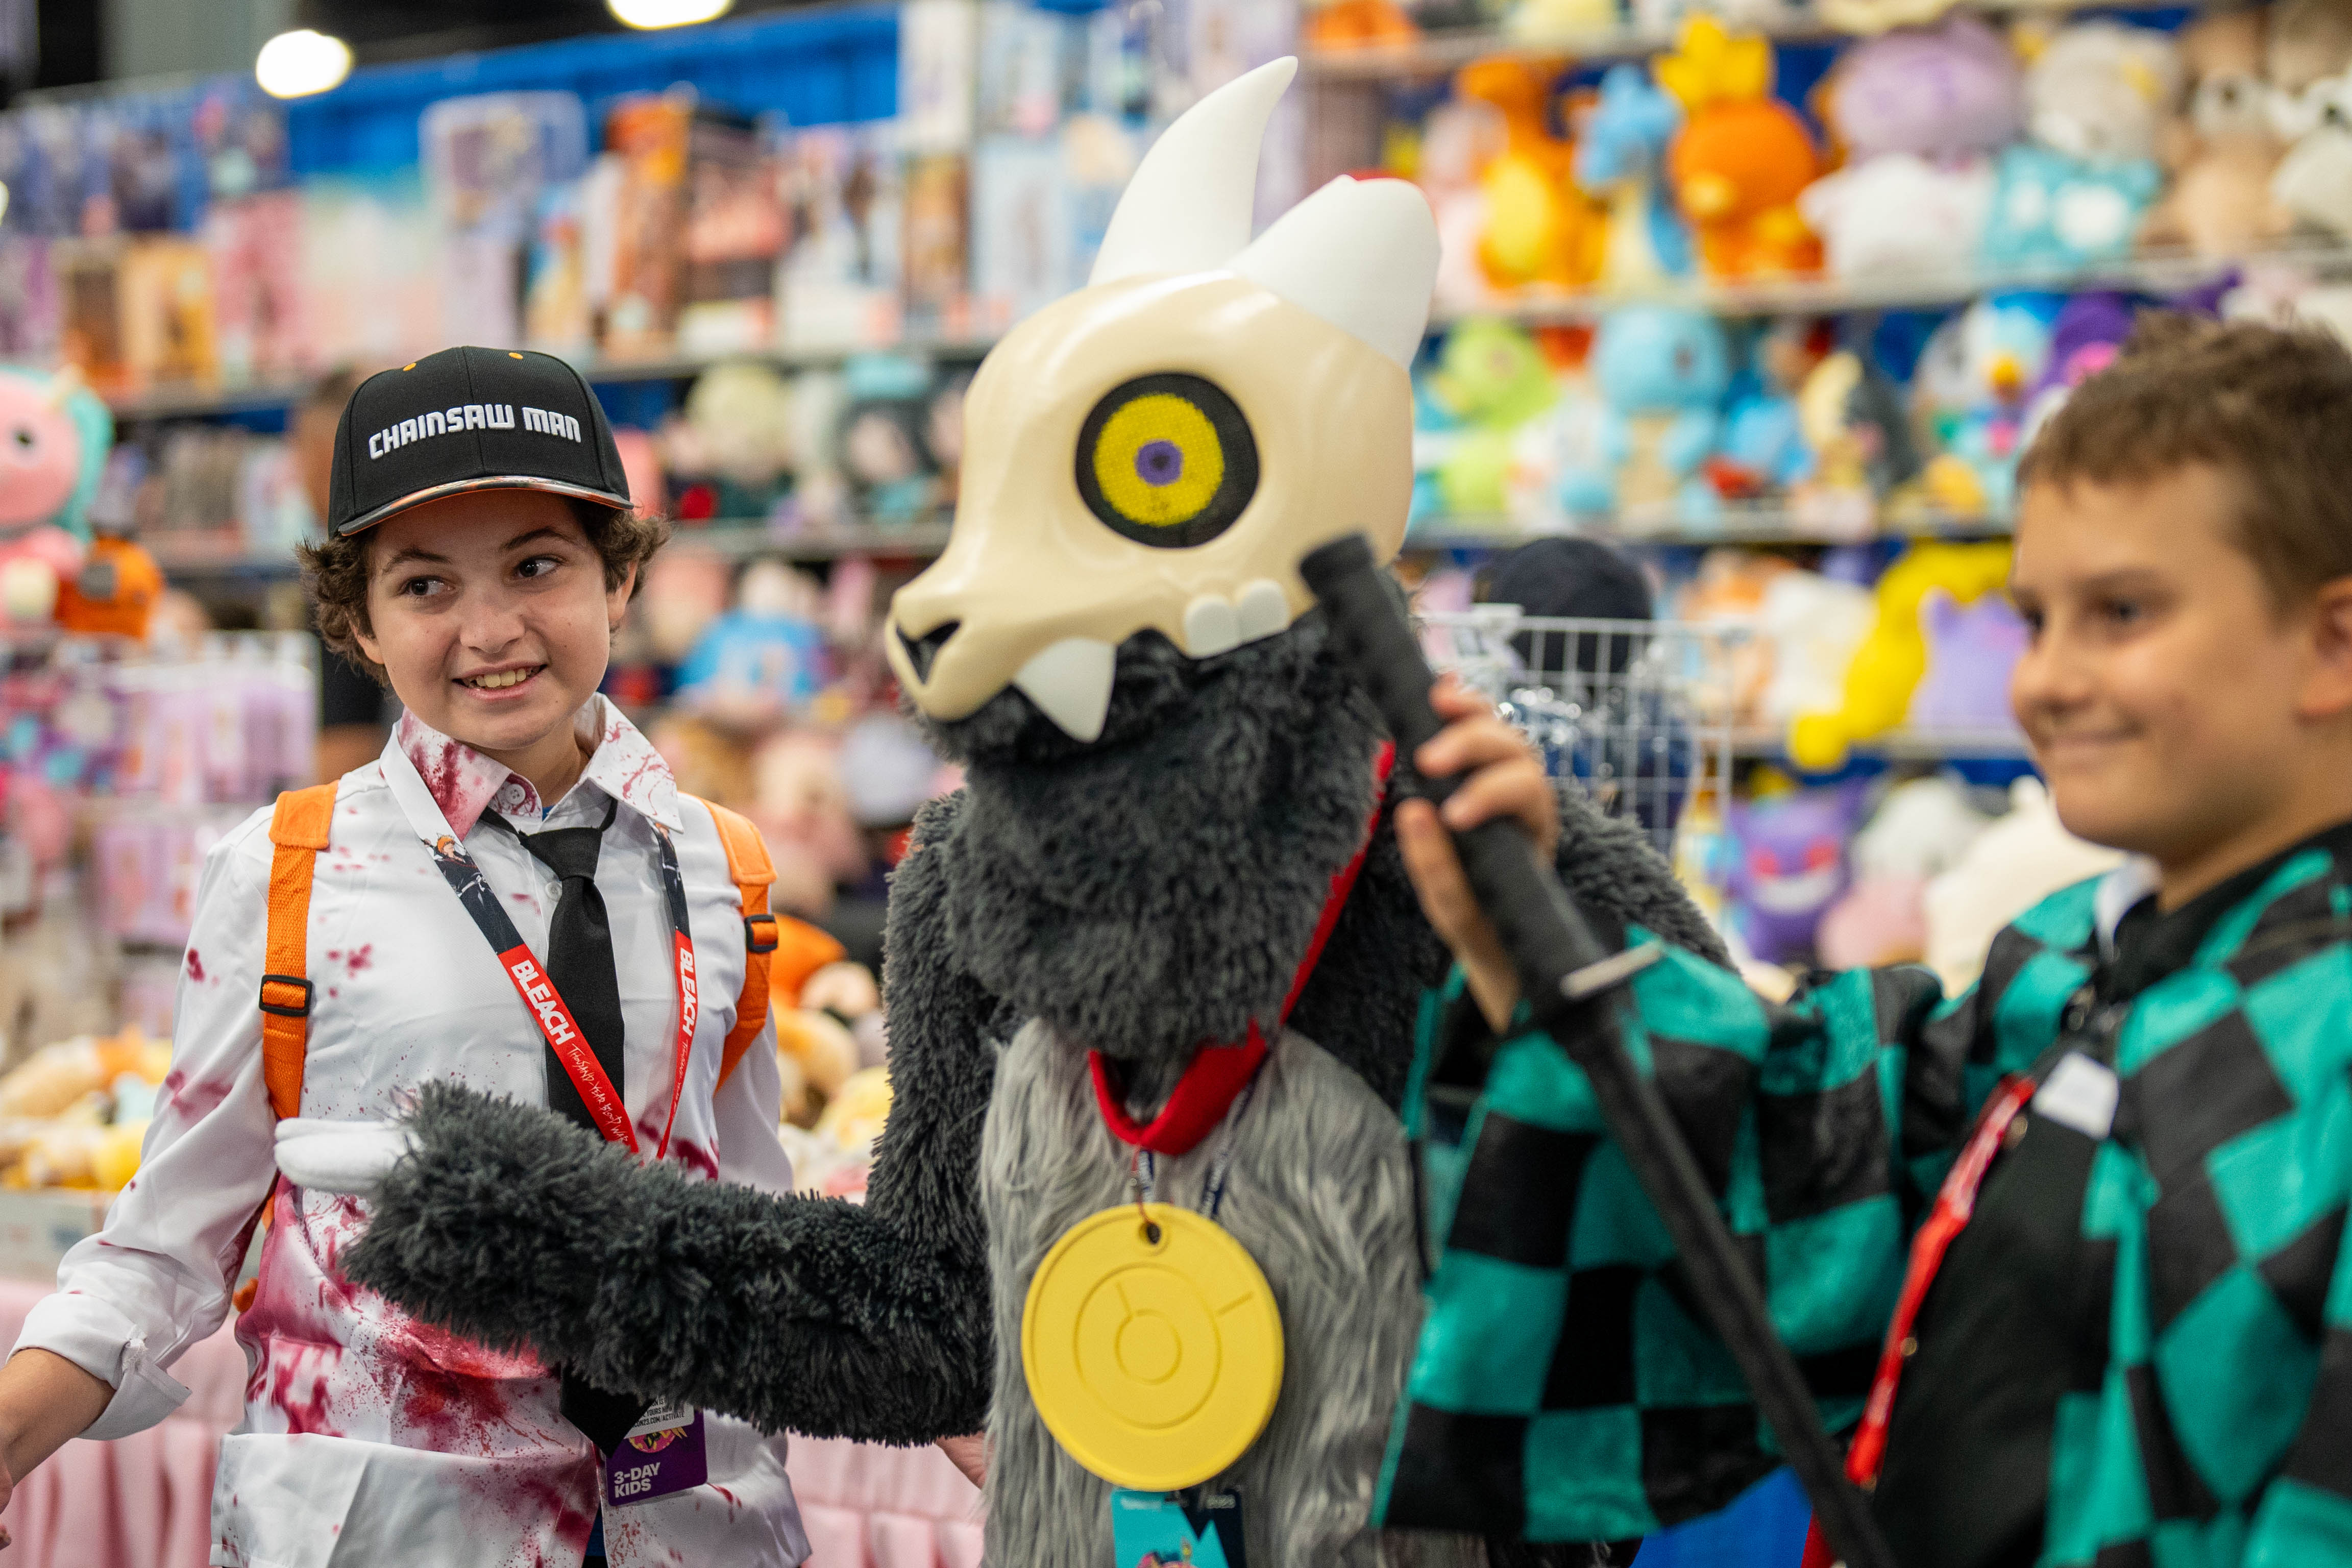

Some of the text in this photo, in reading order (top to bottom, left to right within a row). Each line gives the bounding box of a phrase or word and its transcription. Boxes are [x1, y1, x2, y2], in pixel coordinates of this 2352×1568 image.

[369, 404, 581, 459] CHAINSAW MAN
[511, 960, 576, 1045] BLEACH
[680, 947, 696, 1038] BLEACH
[614, 1462, 660, 1484] 3-DAY
[615, 1478, 652, 1498] KIDS
